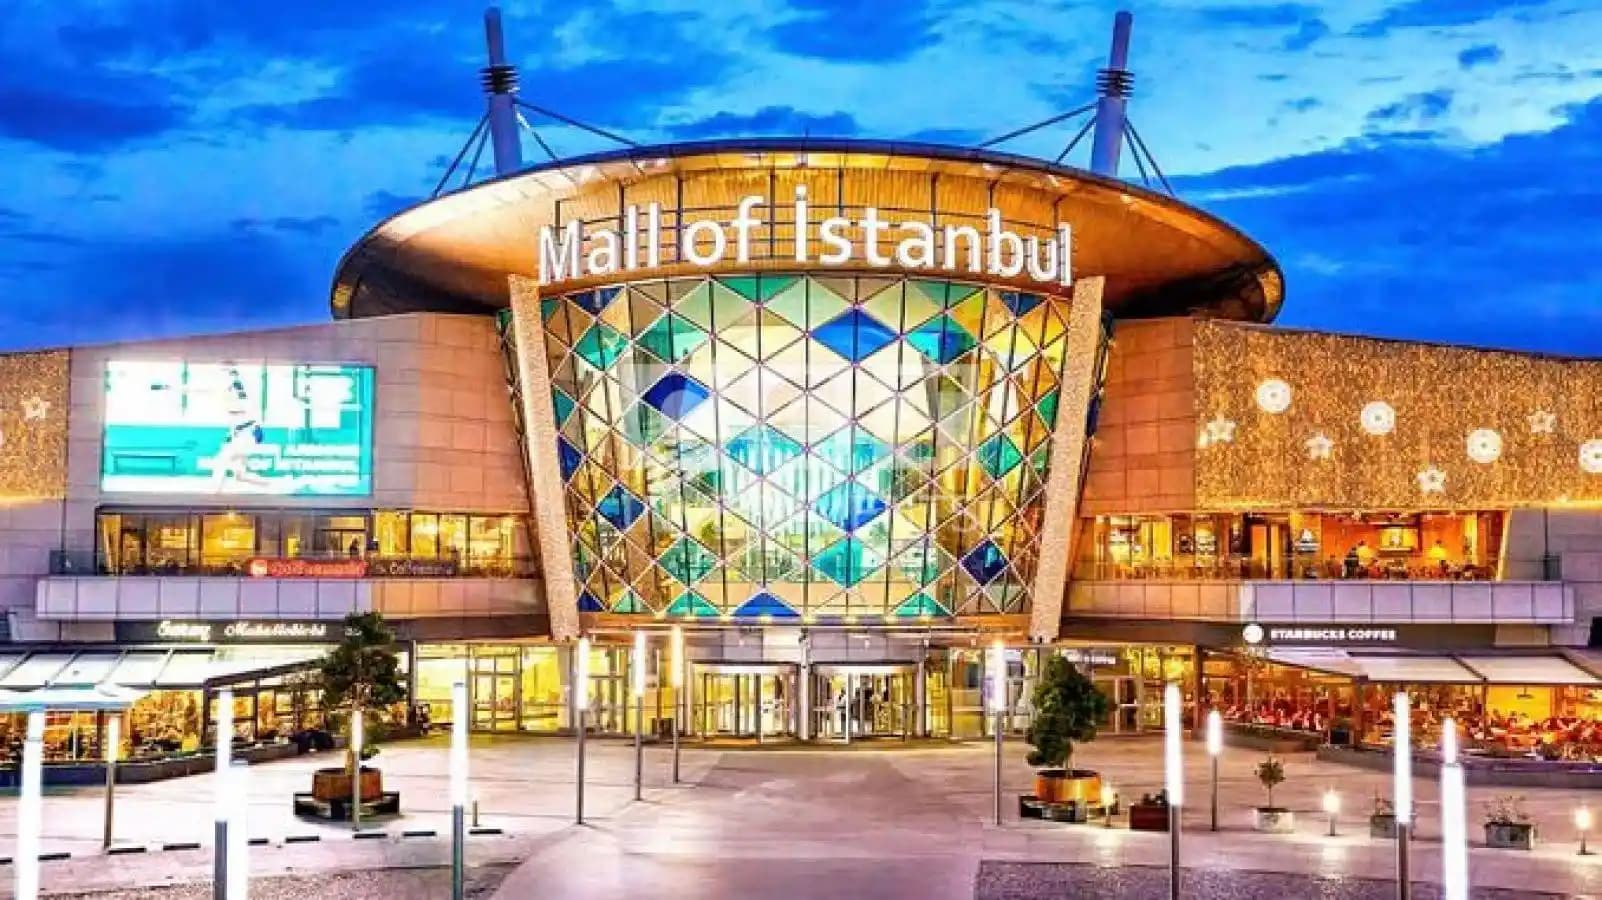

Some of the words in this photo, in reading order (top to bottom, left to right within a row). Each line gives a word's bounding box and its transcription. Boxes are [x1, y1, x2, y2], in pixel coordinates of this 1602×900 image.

[538, 200, 660, 286] Mall
[682, 195, 765, 266] of
[793, 185, 1073, 287] İstanbul
[1270, 629, 1346, 641] STARBUCKS
[1348, 629, 1398, 641] COFFEE
